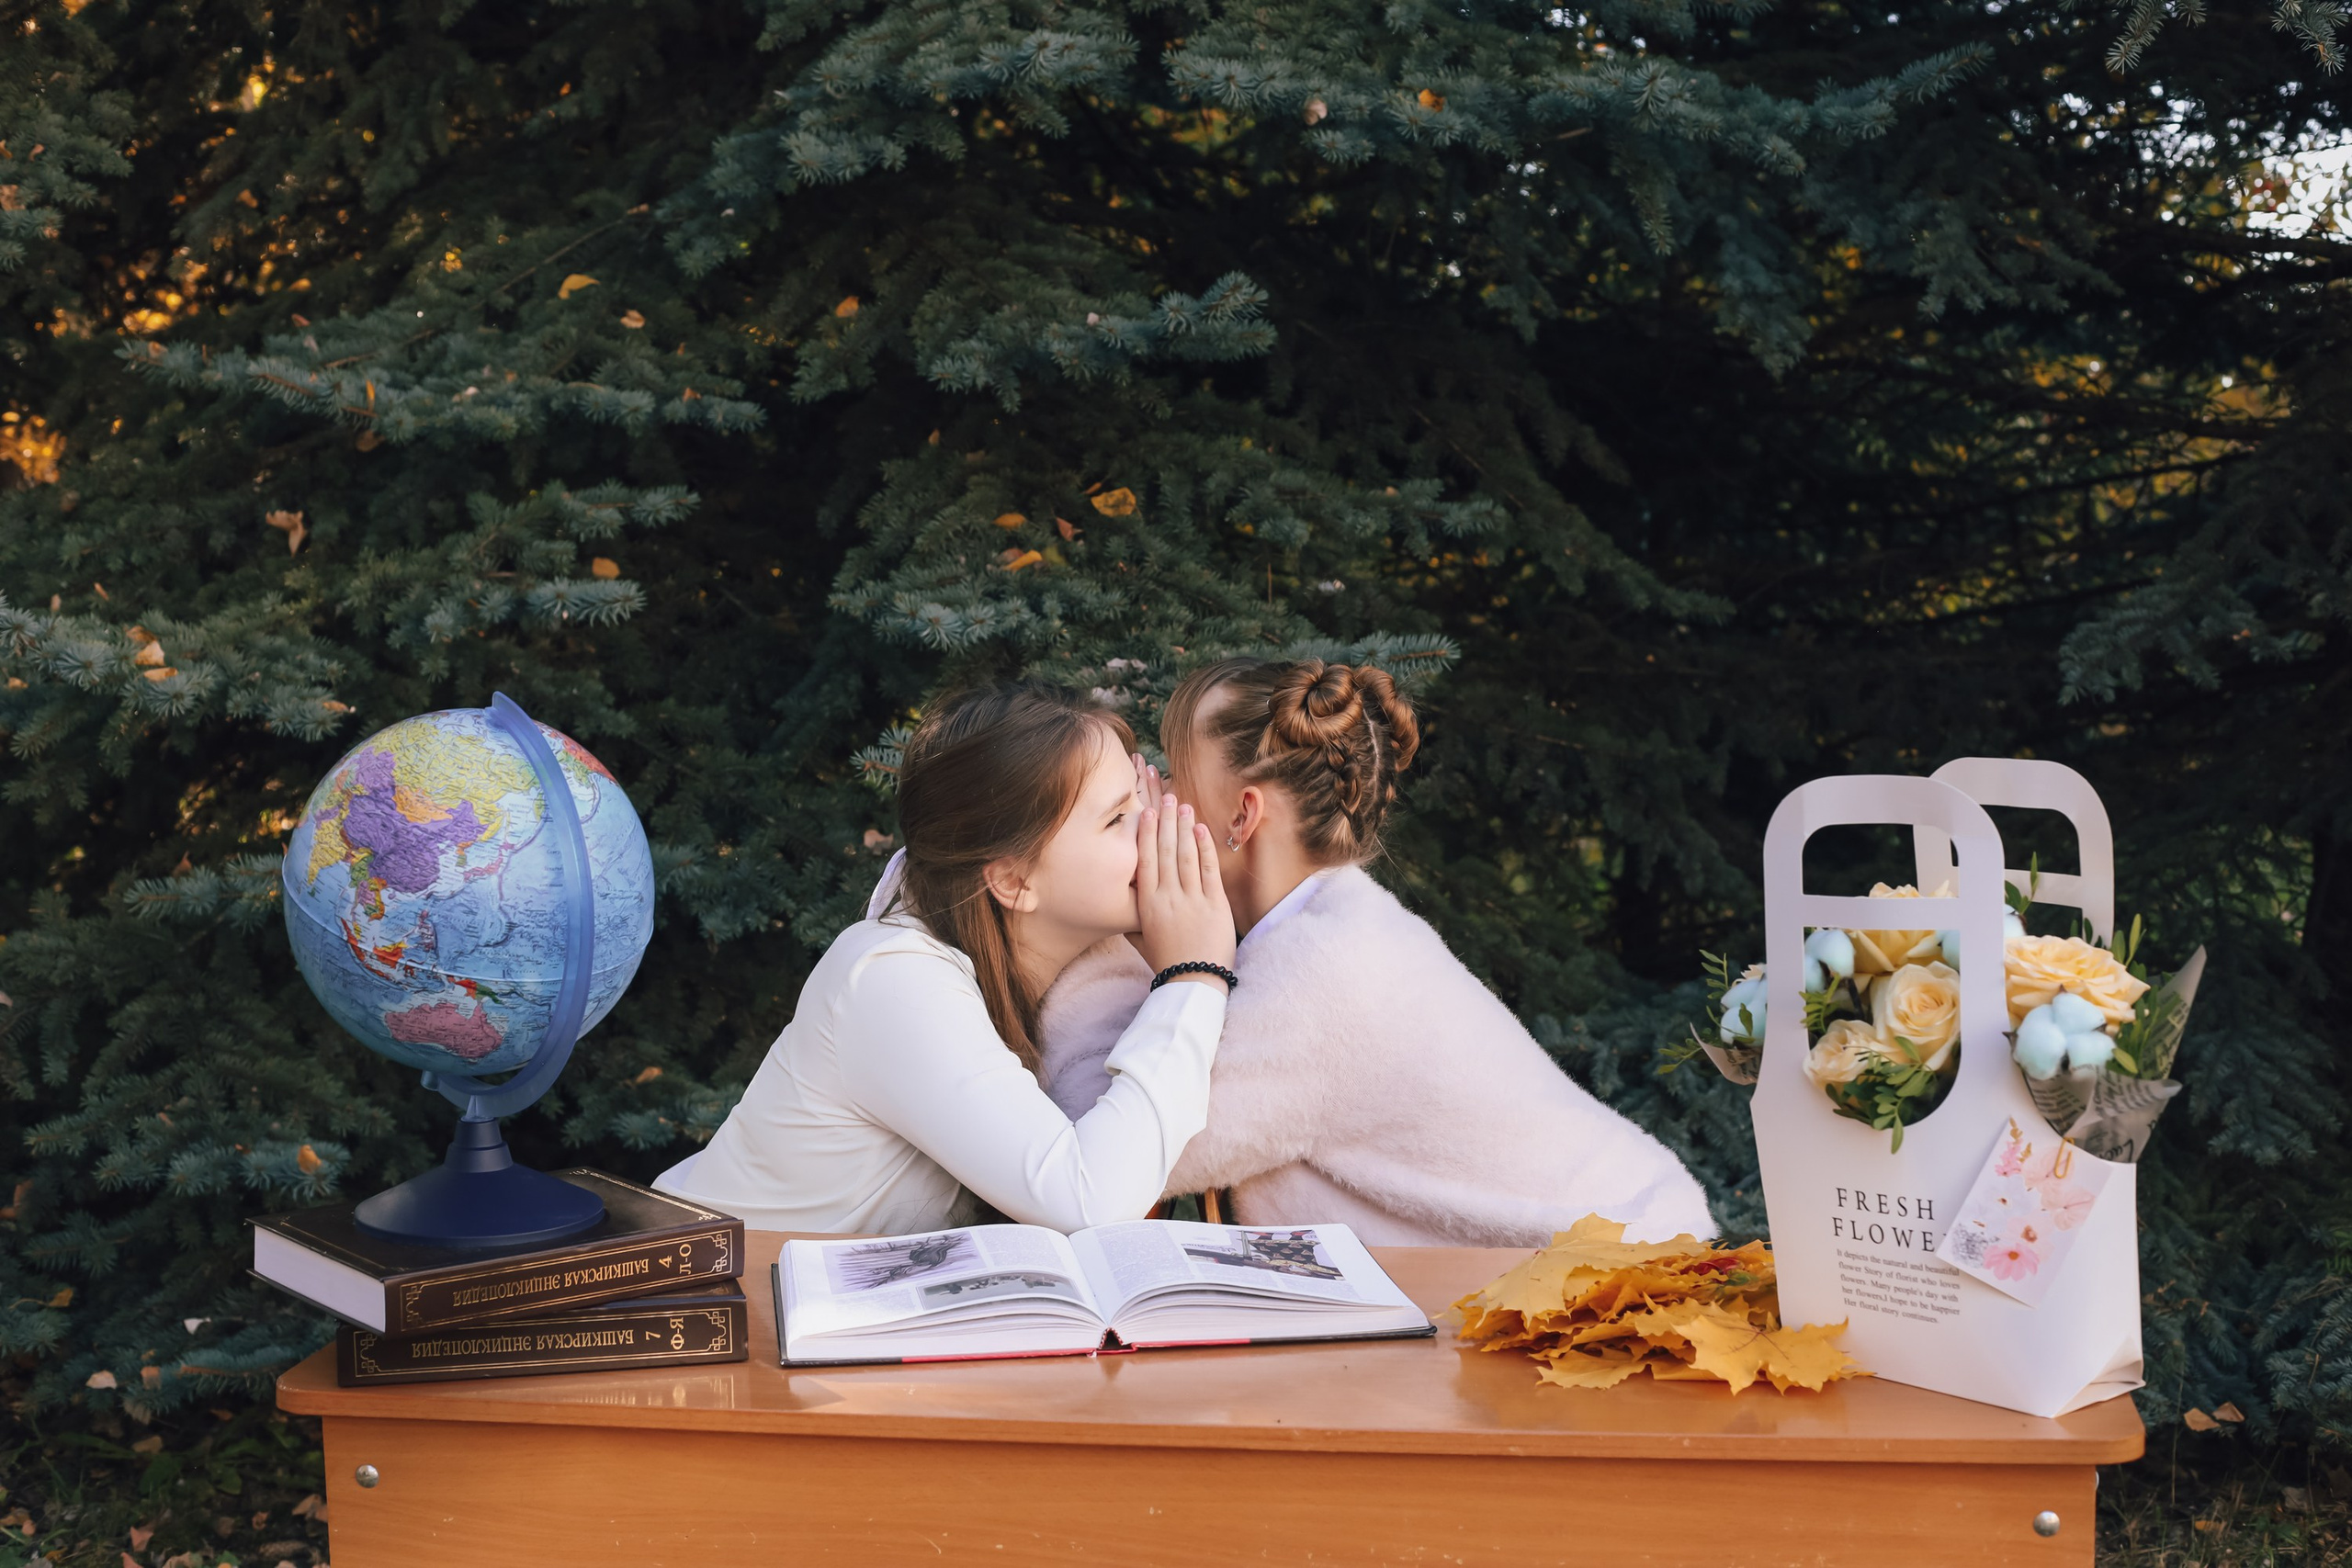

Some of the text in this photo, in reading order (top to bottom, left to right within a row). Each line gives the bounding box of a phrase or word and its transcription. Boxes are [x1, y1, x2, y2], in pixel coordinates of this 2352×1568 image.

[1836, 1187, 1935, 1221] FRESH
[1832, 1216, 1946, 1252] FLOWE
[658, 1255, 673, 1268] 4
[679, 1243, 692, 1275] Л-О
[1844, 1251, 1869, 1262] depicts
[1883, 1258, 1907, 1269] natural
[1926, 1266, 1960, 1276] beautiful
[453, 1258, 649, 1307] БАШКИРСКАЯ ЭНЦИКЛОПЕДИЯ
[1839, 1262, 1861, 1272] flower
[1864, 1268, 1883, 1279] Story
[1896, 1272, 1918, 1283] florist
[1921, 1278, 1937, 1286] who
[1939, 1280, 1961, 1290] loves
[1842, 1286, 1852, 1294] her
[1890, 1296, 1907, 1306] hope
[1931, 1304, 1961, 1315] happier
[1871, 1280, 1891, 1292] Many
[1894, 1285, 1923, 1296] people's
[1926, 1290, 1939, 1301] day
[1942, 1294, 1959, 1303] with
[1844, 1298, 1857, 1306] Her
[1860, 1301, 1879, 1311] floral
[1881, 1307, 1899, 1317] story
[412, 1328, 634, 1359] БАШКИРСКАЯ ЭНЦИКЛОПЕДИЯ
[645, 1328, 662, 1340] 7
[670, 1316, 684, 1350] Ф-Я
